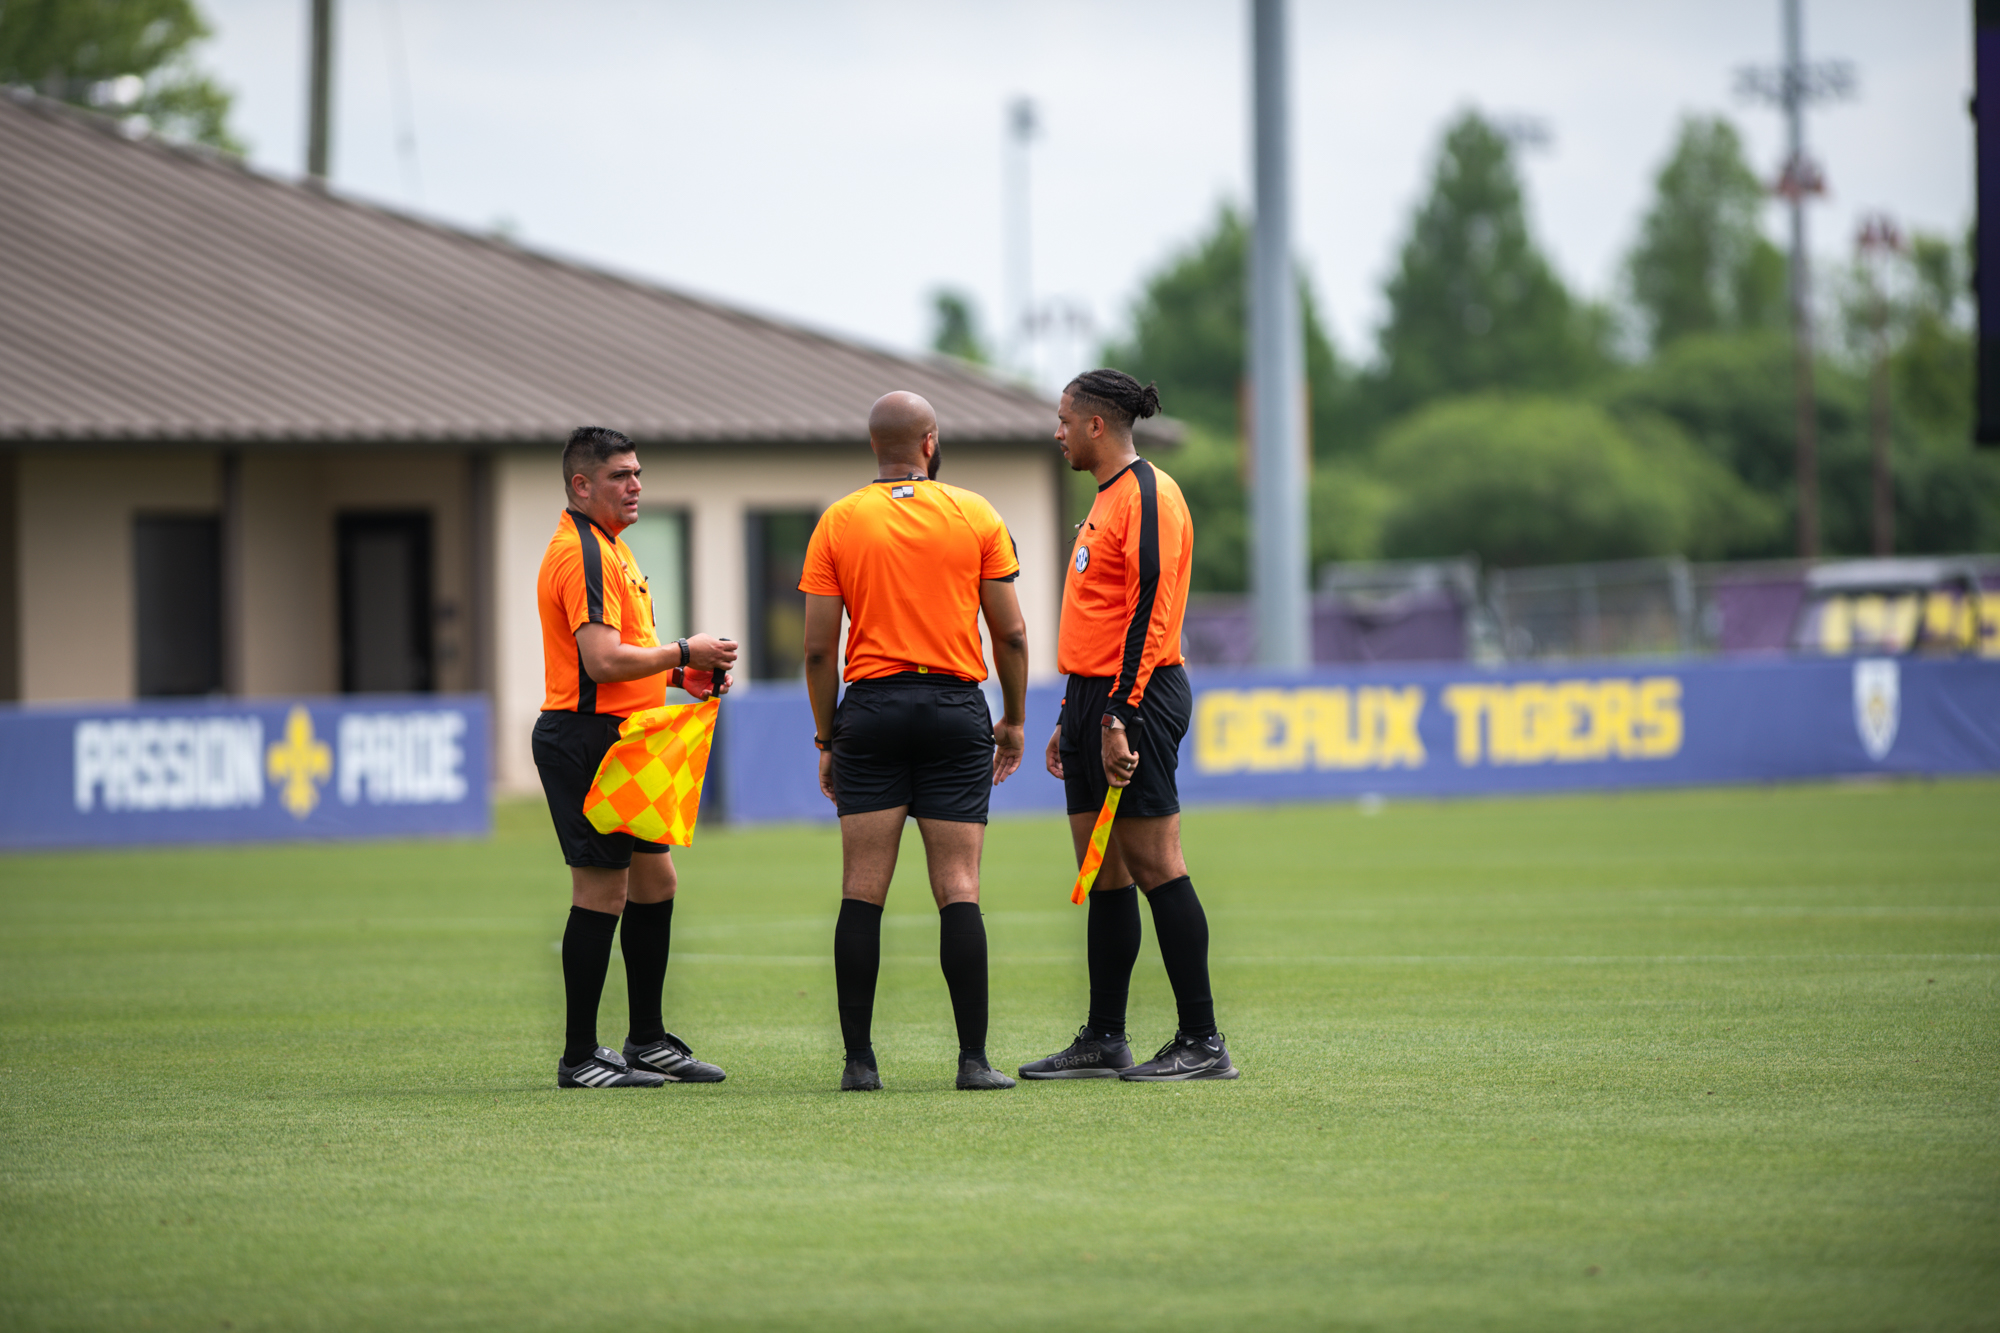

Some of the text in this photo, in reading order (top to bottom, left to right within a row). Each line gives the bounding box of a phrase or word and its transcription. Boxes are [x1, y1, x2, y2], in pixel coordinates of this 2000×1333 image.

[74, 711, 467, 812] PASSION PRIDE
[1195, 677, 1683, 773] GEAUX TIGERS
